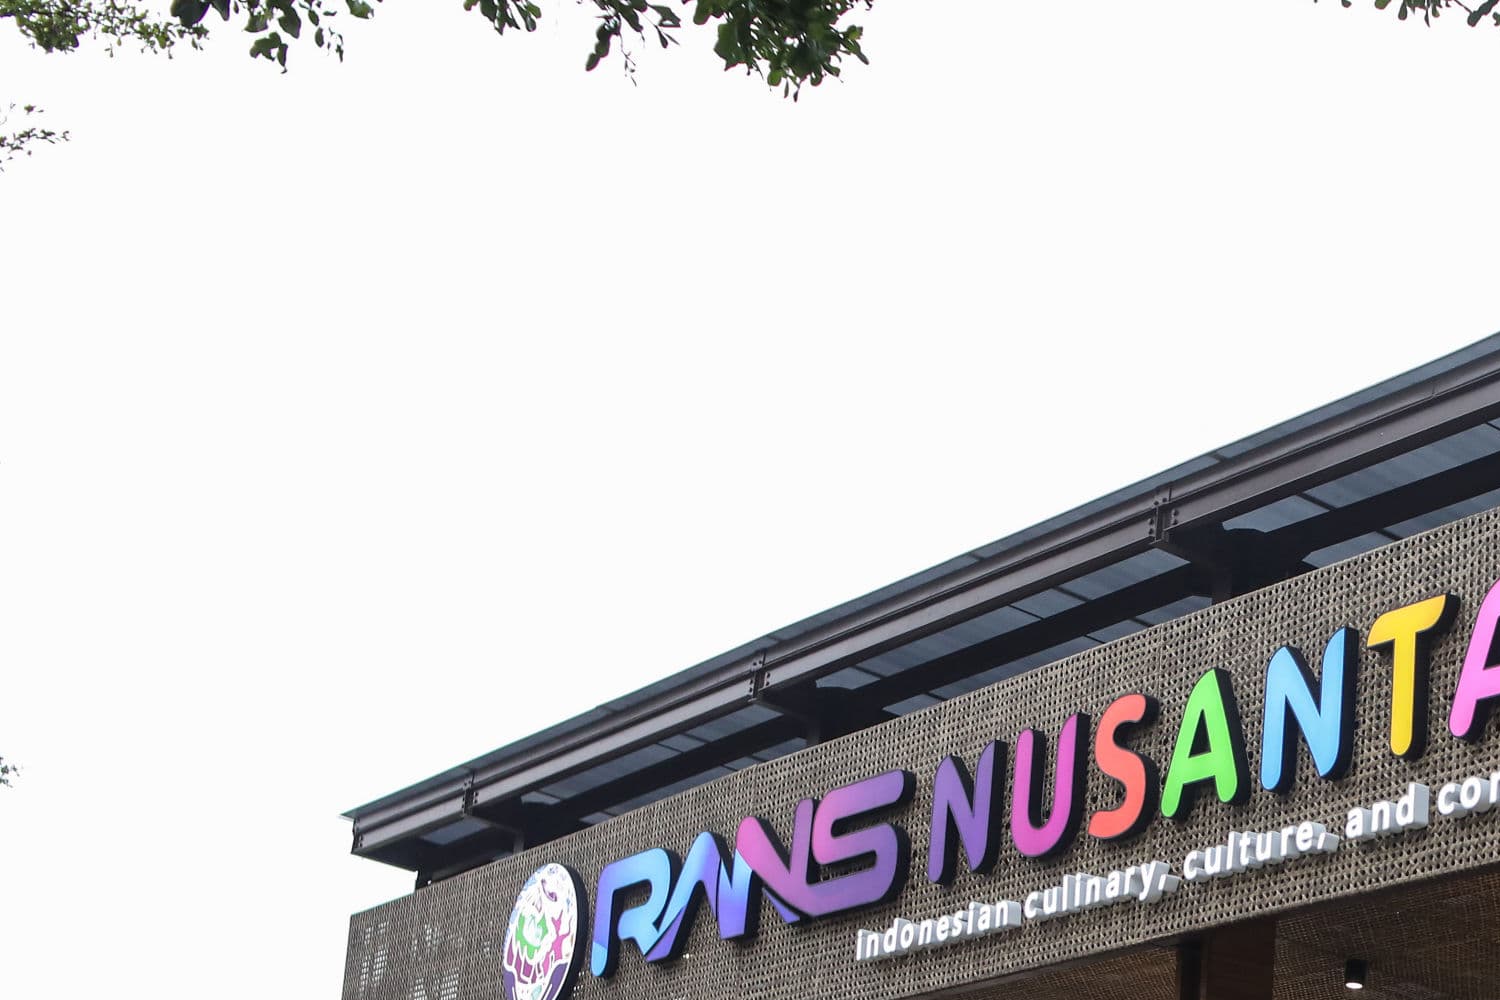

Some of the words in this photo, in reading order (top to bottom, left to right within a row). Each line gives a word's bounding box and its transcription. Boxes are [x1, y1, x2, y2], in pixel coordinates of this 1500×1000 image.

[591, 769, 909, 978] RANS
[1023, 861, 1168, 919] culinary,
[1183, 820, 1328, 881] culture,
[1346, 784, 1416, 839] and
